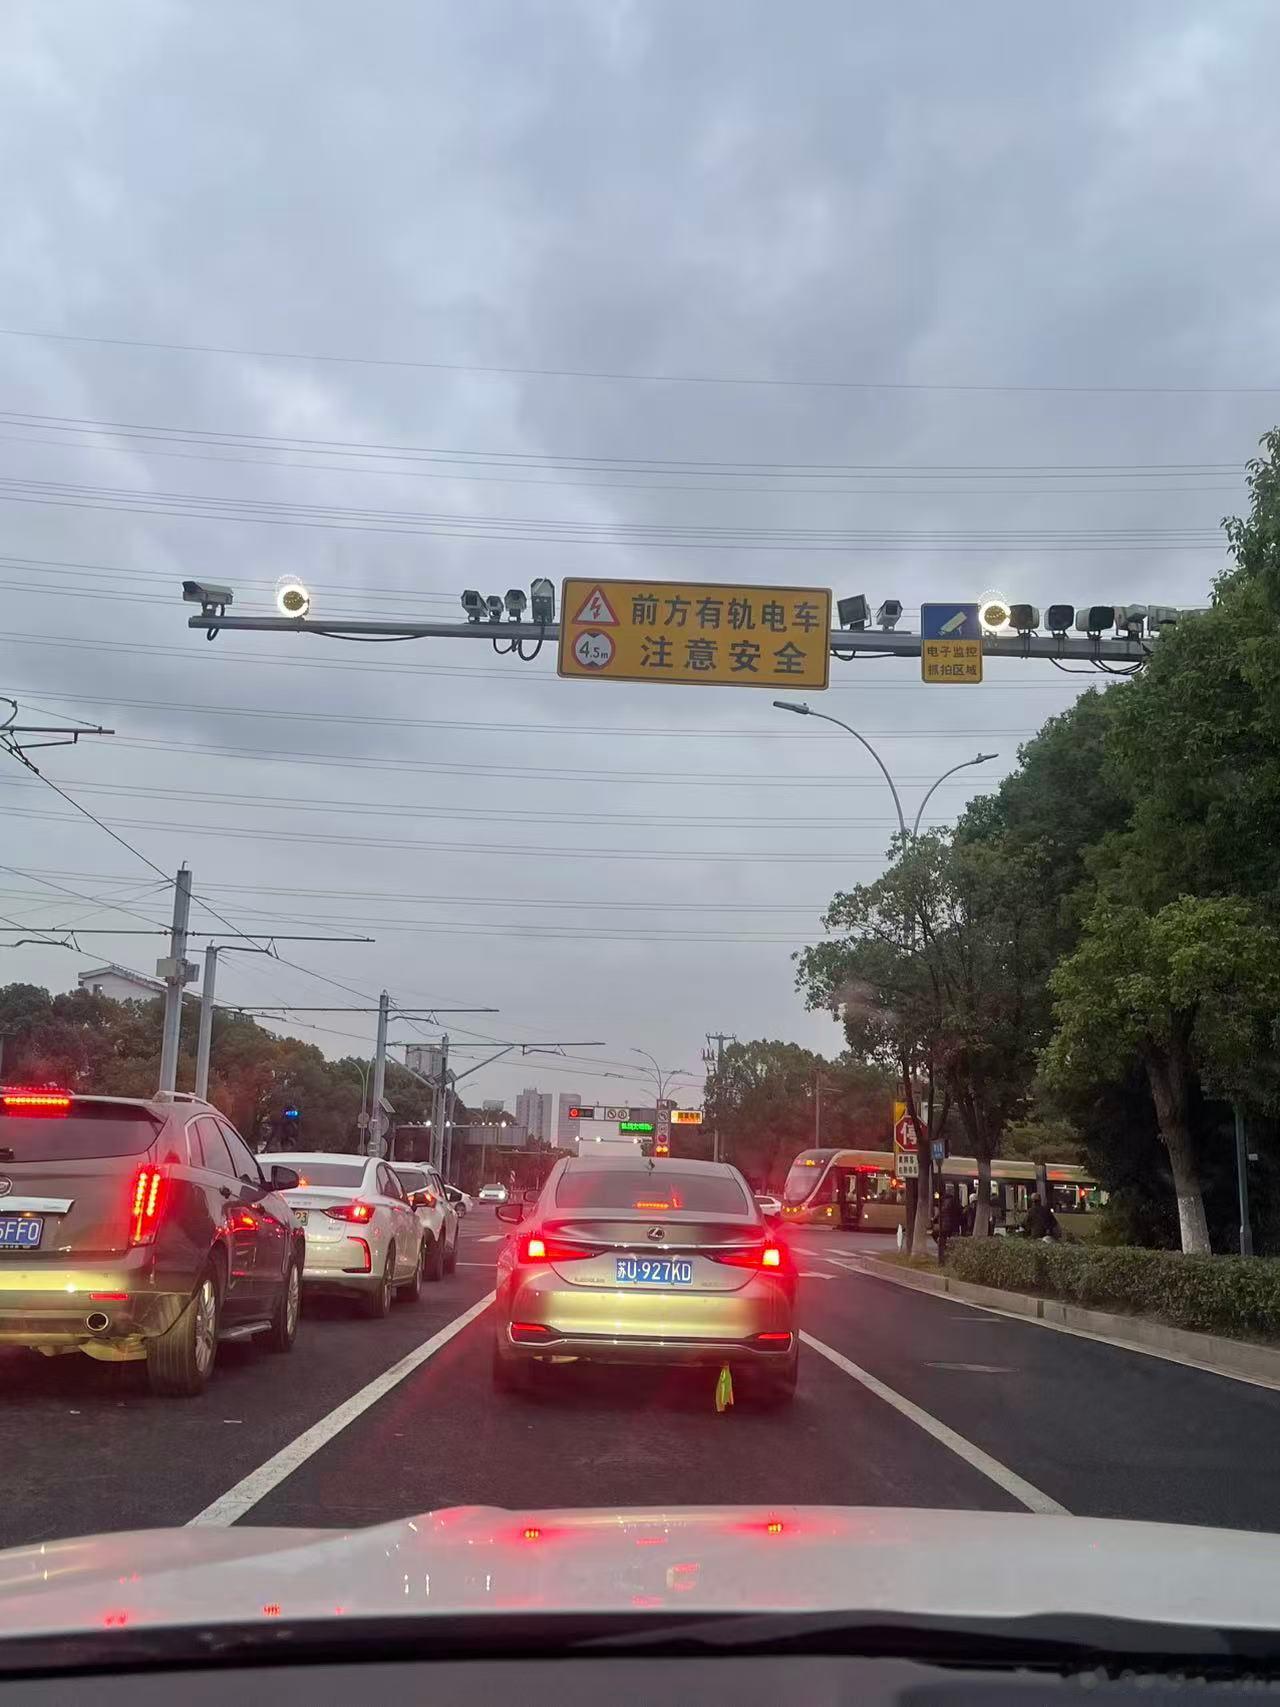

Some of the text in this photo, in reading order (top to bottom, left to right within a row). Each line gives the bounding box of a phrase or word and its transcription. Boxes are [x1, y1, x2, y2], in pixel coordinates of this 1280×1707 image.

[631, 594, 820, 633] 前方有轨电车
[579, 641, 609, 659] 4.5m
[640, 635, 807, 674] 注意安全
[927, 646, 978, 658] 电子监控
